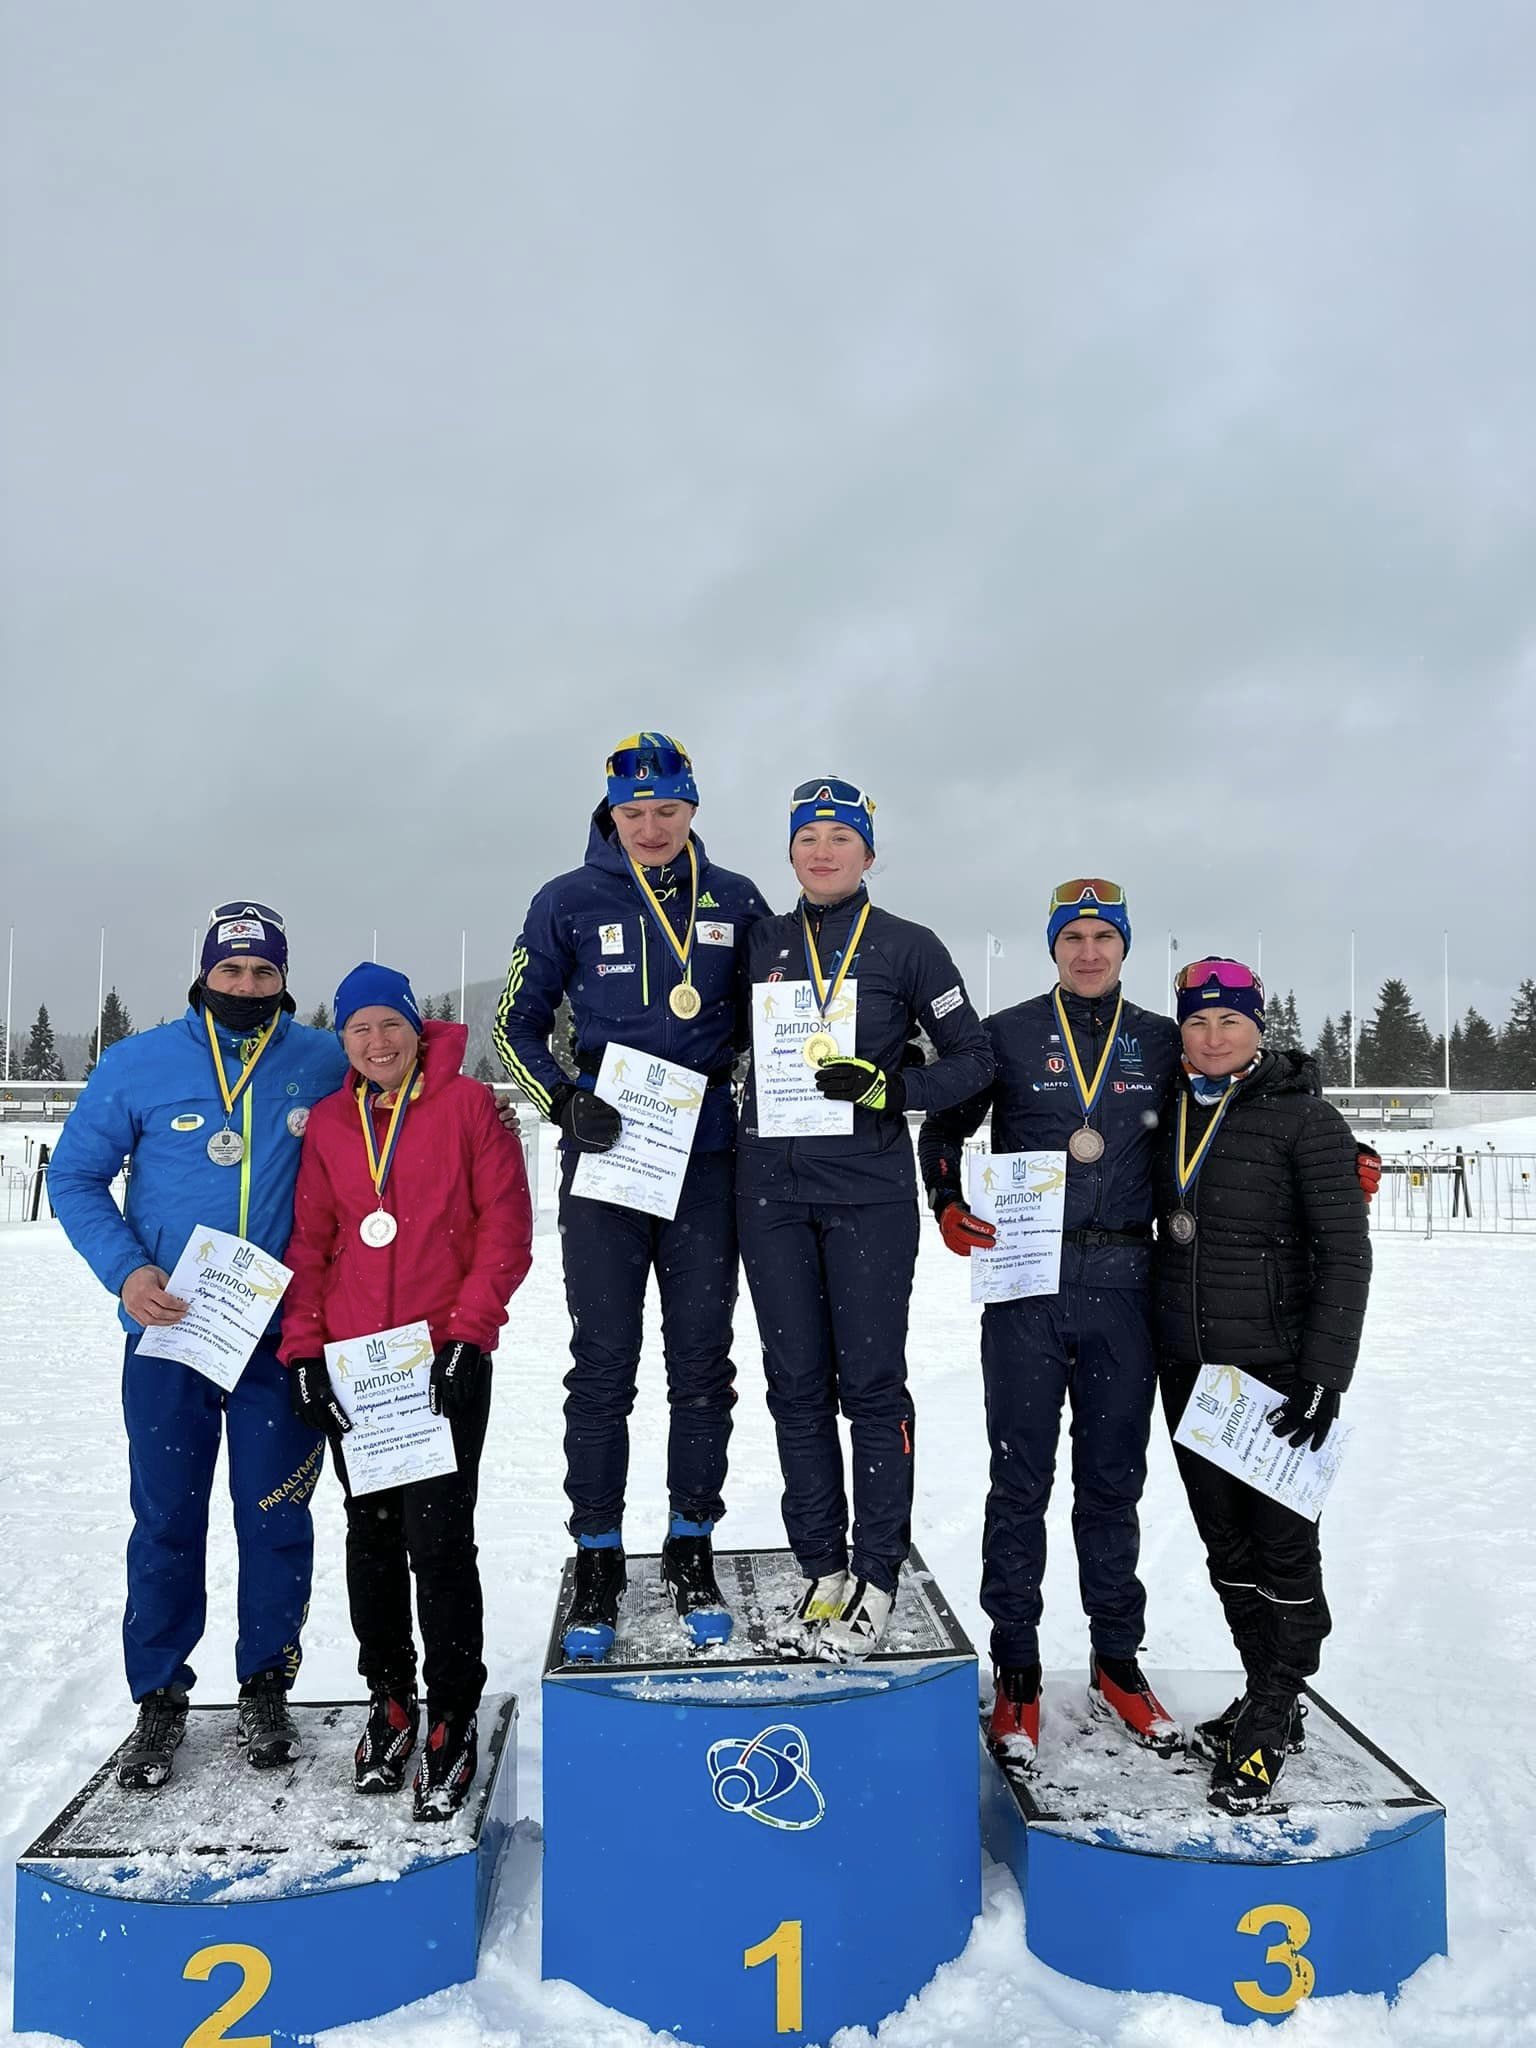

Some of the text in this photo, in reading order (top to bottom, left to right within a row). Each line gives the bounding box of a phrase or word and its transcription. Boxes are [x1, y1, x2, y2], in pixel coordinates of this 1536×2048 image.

[775, 1022, 832, 1037] ДИПЛОМ
[618, 1089, 678, 1117] ДИПЛОМ
[994, 1192, 1042, 1208] ДИПЛОМ
[199, 1267, 257, 1301] ДИПЛОМ
[445, 1342, 464, 1377] Roeck
[298, 1367, 311, 1404] Roeckl
[353, 1368, 414, 1394] ДИПЛОМ
[328, 1402, 350, 1429] Roeckl
[1304, 1384, 1325, 1419] Roeckl
[1220, 1393, 1250, 1448] ДИПЛОМ
[352, 1445, 362, 1453] НА
[258, 1440, 324, 1512] PARALYMPIC
[289, 1468, 319, 1505] TEAM
[744, 1920, 802, 2033] 1
[1233, 1904, 1316, 2014] 3
[183, 1943, 272, 2048] 2
